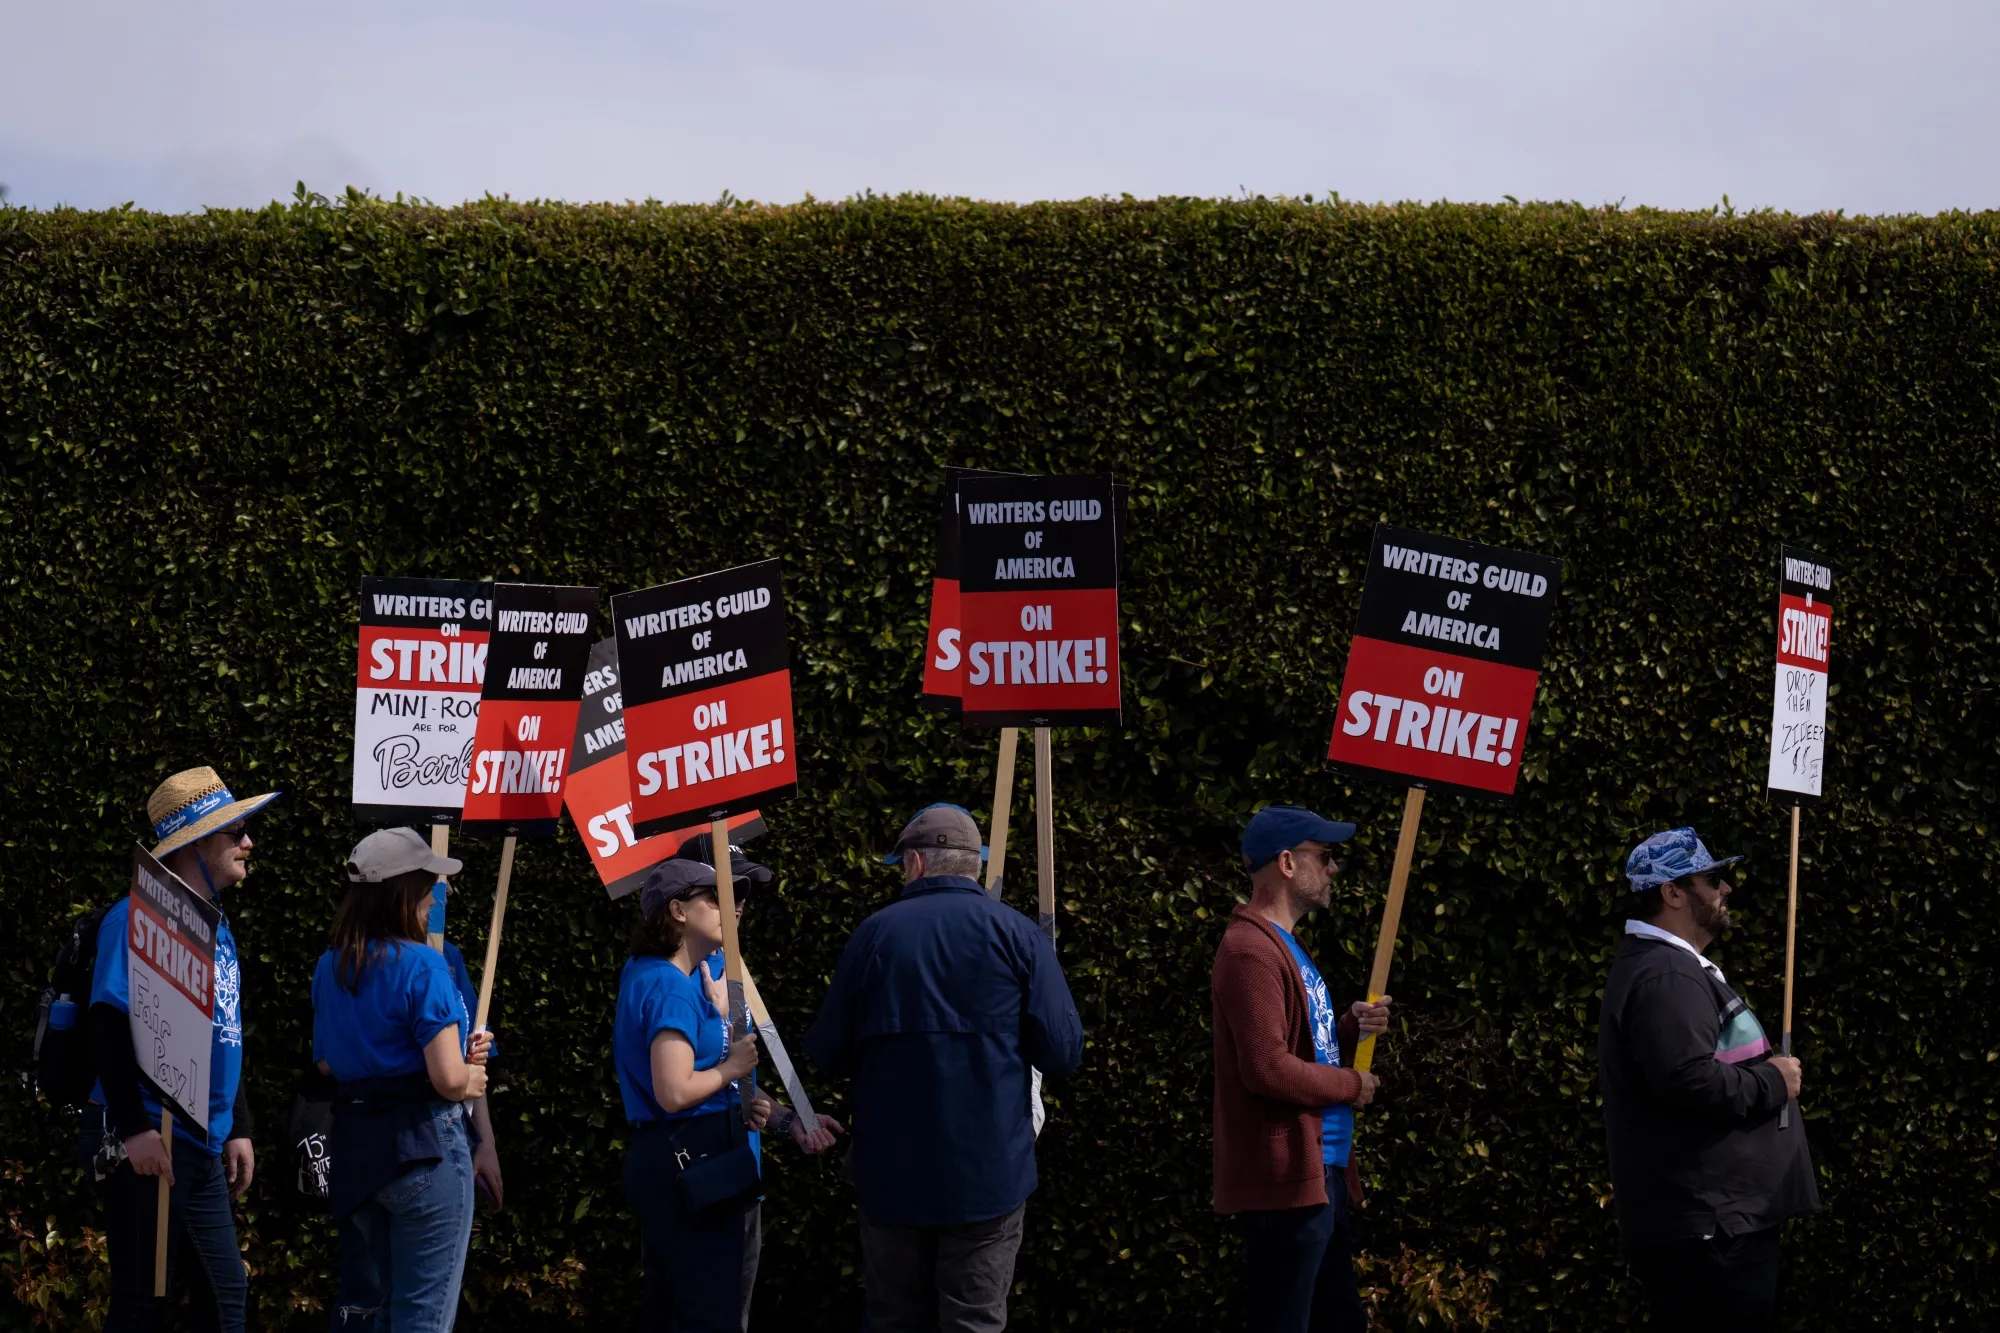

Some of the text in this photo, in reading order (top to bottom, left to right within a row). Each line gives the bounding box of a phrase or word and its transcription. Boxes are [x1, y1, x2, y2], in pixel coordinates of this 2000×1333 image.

[968, 500, 1101, 525] WRITERS GUILD
[1024, 531, 1043, 549] OF
[994, 557, 1075, 580] AMERICA
[1383, 544, 1547, 598] WRITERS GUILD
[1785, 557, 1831, 590] WRITERS GUILD
[373, 594, 466, 618] WRITERS
[625, 587, 771, 640] WRITERS GUILD
[1446, 590, 1471, 611] OF
[1806, 592, 1812, 608] ON
[440, 623, 460, 637] ON
[498, 610, 588, 634] WRITERS GUILD
[1020, 605, 1052, 631] ON
[1401, 611, 1500, 650] AMERICA
[533, 641, 548, 660] OF
[691, 630, 712, 651] OF
[1781, 608, 1829, 663] STRIKE!
[370, 638, 489, 685] STRIK
[661, 648, 748, 688] AMERICA
[968, 637, 1108, 686] STRIKE!
[507, 667, 562, 690] AMERICA
[582, 665, 617, 697] ERS
[1423, 667, 1464, 698] ON
[1786, 670, 1815, 696] DROP
[602, 692, 623, 713] OF
[693, 700, 727, 731] ON
[412, 722, 459, 734] ARE FOR
[518, 715, 541, 741] ON
[584, 717, 626, 755] AME
[1342, 690, 1519, 767] STRIKE!
[471, 748, 566, 794] STRIKE!
[637, 717, 786, 797] STRIKE!
[587, 801, 638, 858] ST
[138, 864, 210, 944] WRITERS GUILD
[167, 917, 178, 934] ON
[133, 909, 208, 1006] STRIKE!
[133, 964, 171, 1038] Fair
[154, 1037, 197, 1115] Pay!
